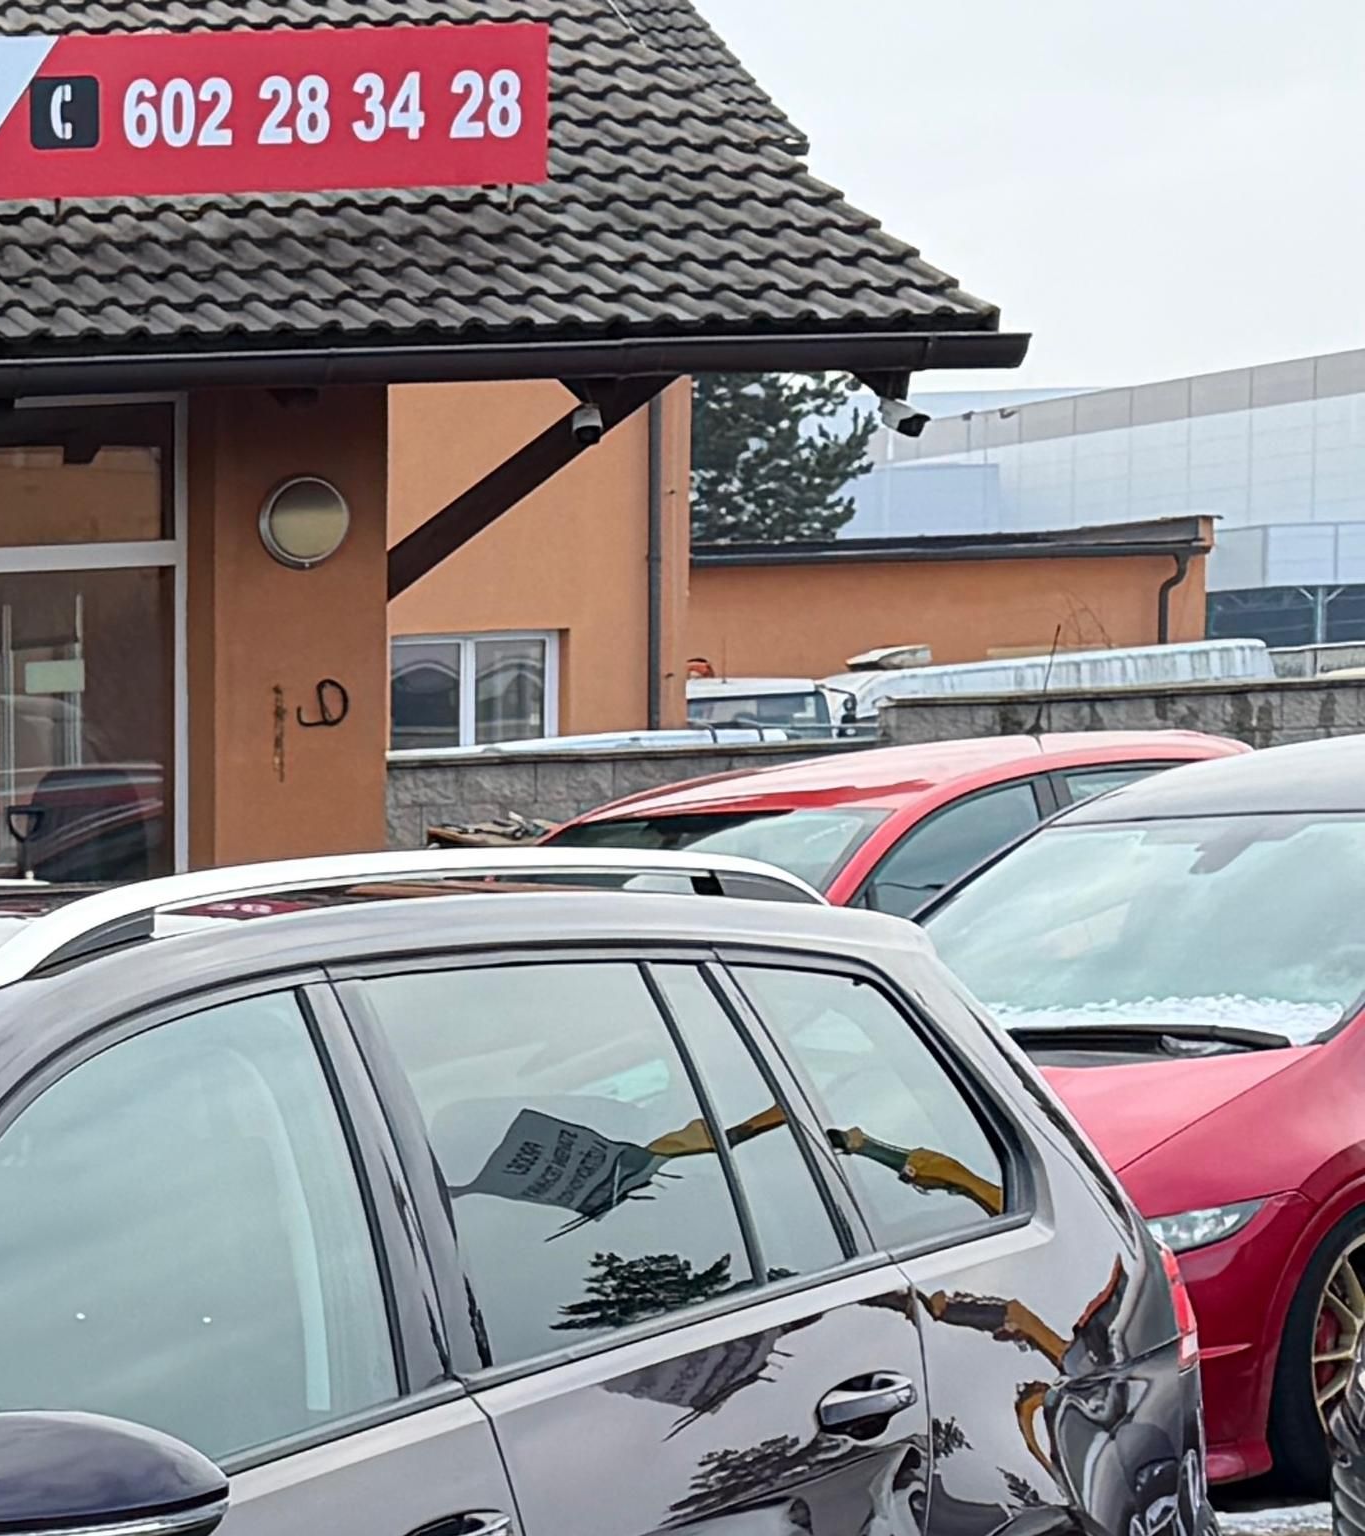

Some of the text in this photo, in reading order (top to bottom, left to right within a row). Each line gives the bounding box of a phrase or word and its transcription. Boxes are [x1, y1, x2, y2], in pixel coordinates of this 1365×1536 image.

[121, 69, 523, 148] 602 28 34 28
